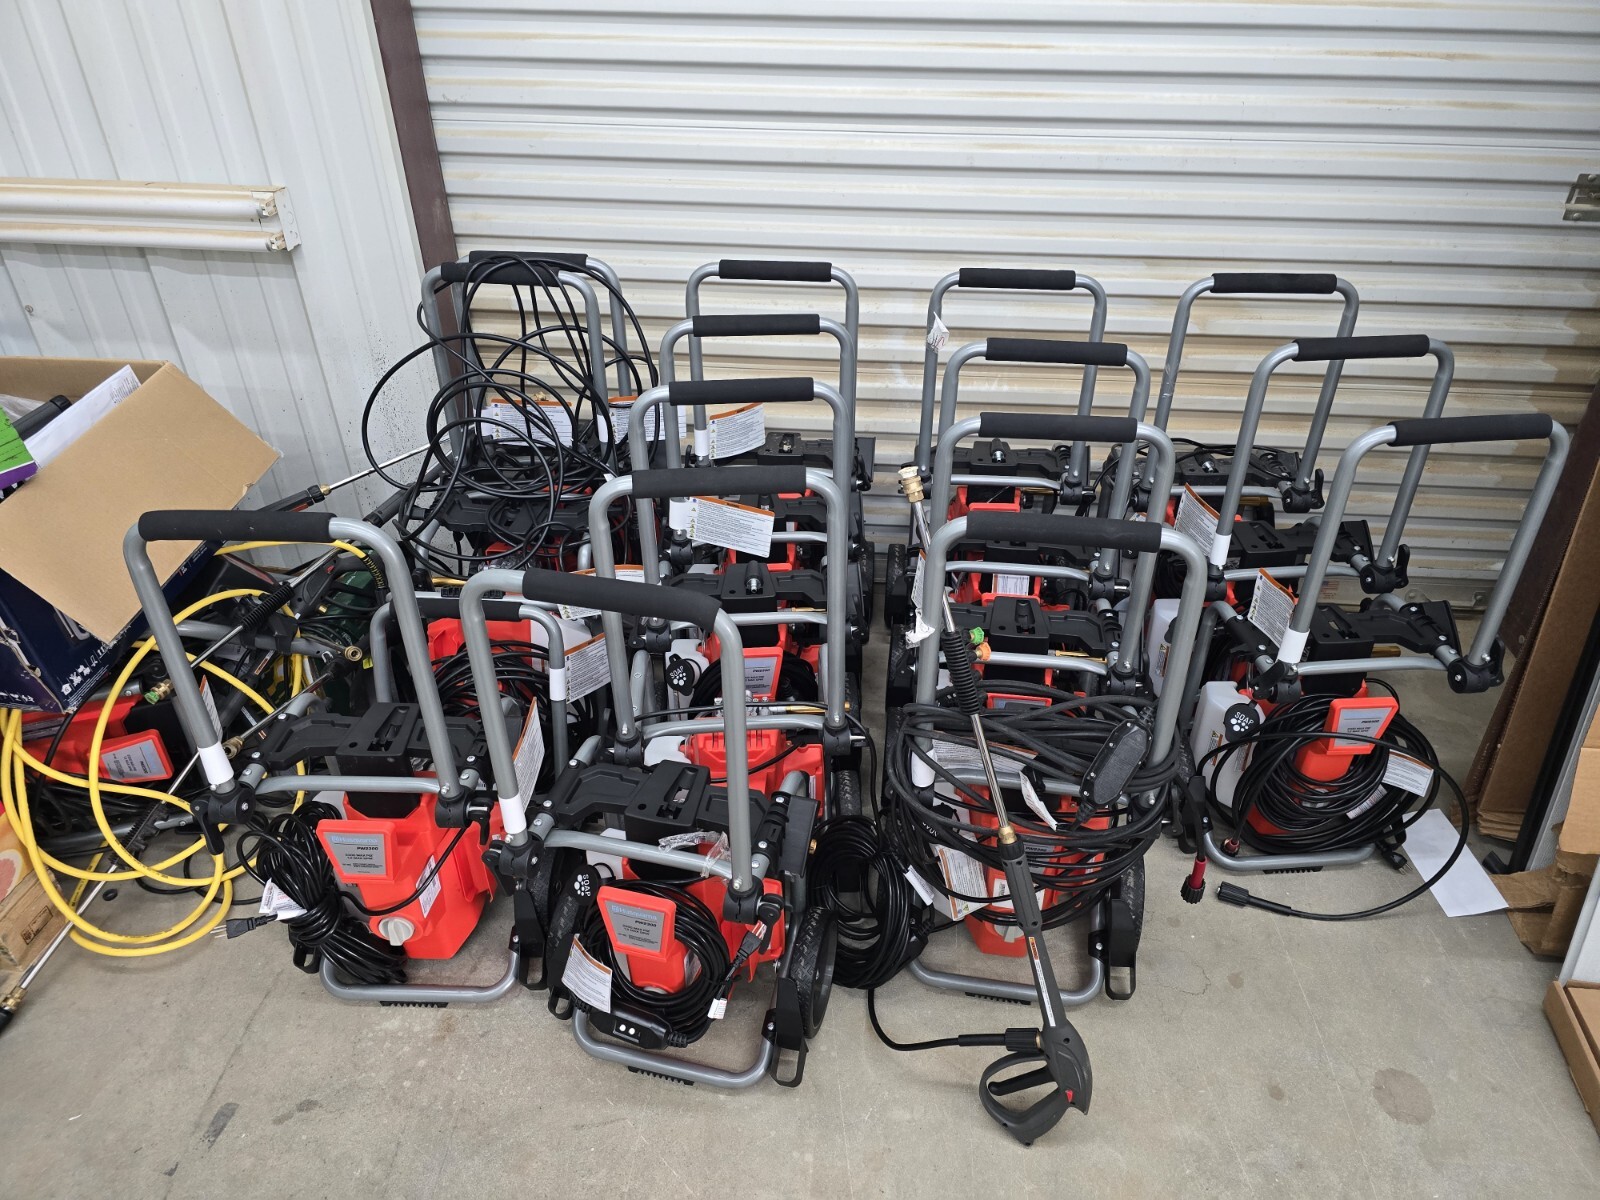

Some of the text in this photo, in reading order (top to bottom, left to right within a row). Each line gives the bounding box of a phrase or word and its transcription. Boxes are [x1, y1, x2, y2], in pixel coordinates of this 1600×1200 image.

[669, 666, 683, 679] SOAP
[1234, 711, 1254, 725] SOAP
[582, 874, 591, 897] SOAP
